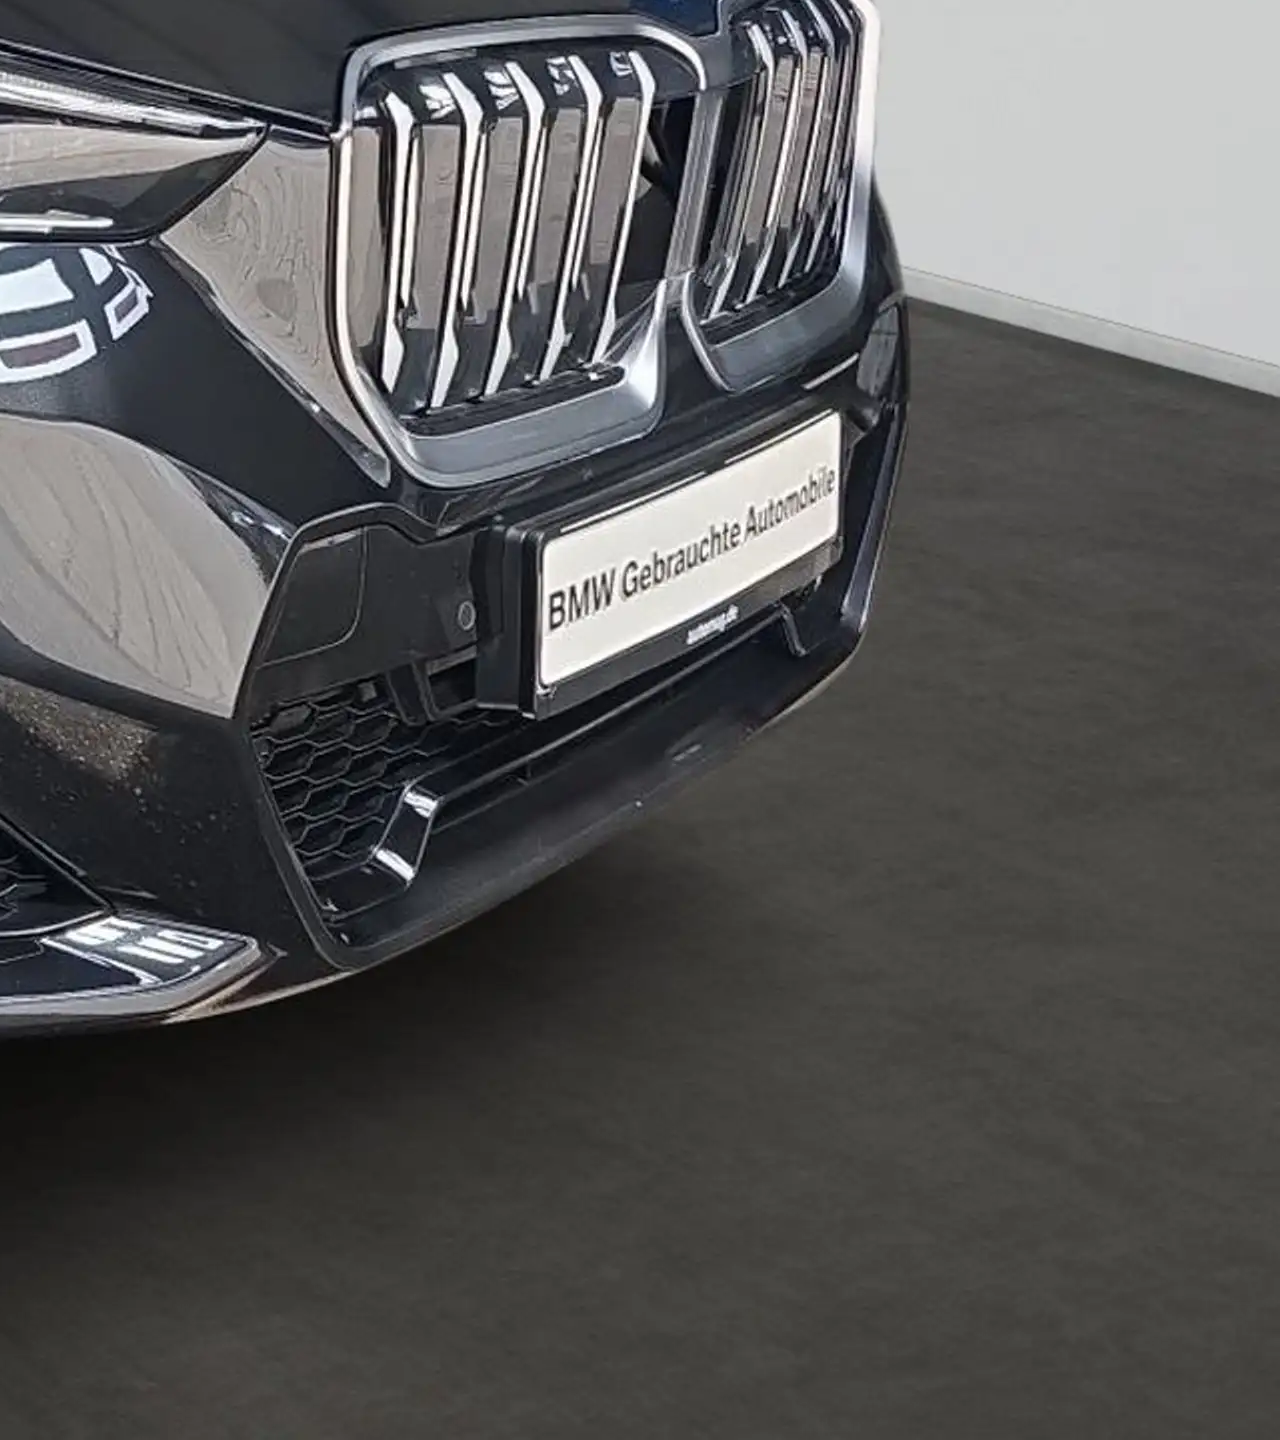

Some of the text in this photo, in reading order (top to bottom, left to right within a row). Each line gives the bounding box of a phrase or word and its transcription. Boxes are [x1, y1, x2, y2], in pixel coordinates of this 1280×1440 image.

[547, 566, 618, 632] BMW
[621, 521, 742, 601] Gebrauchte
[744, 464, 837, 539] Automobile
